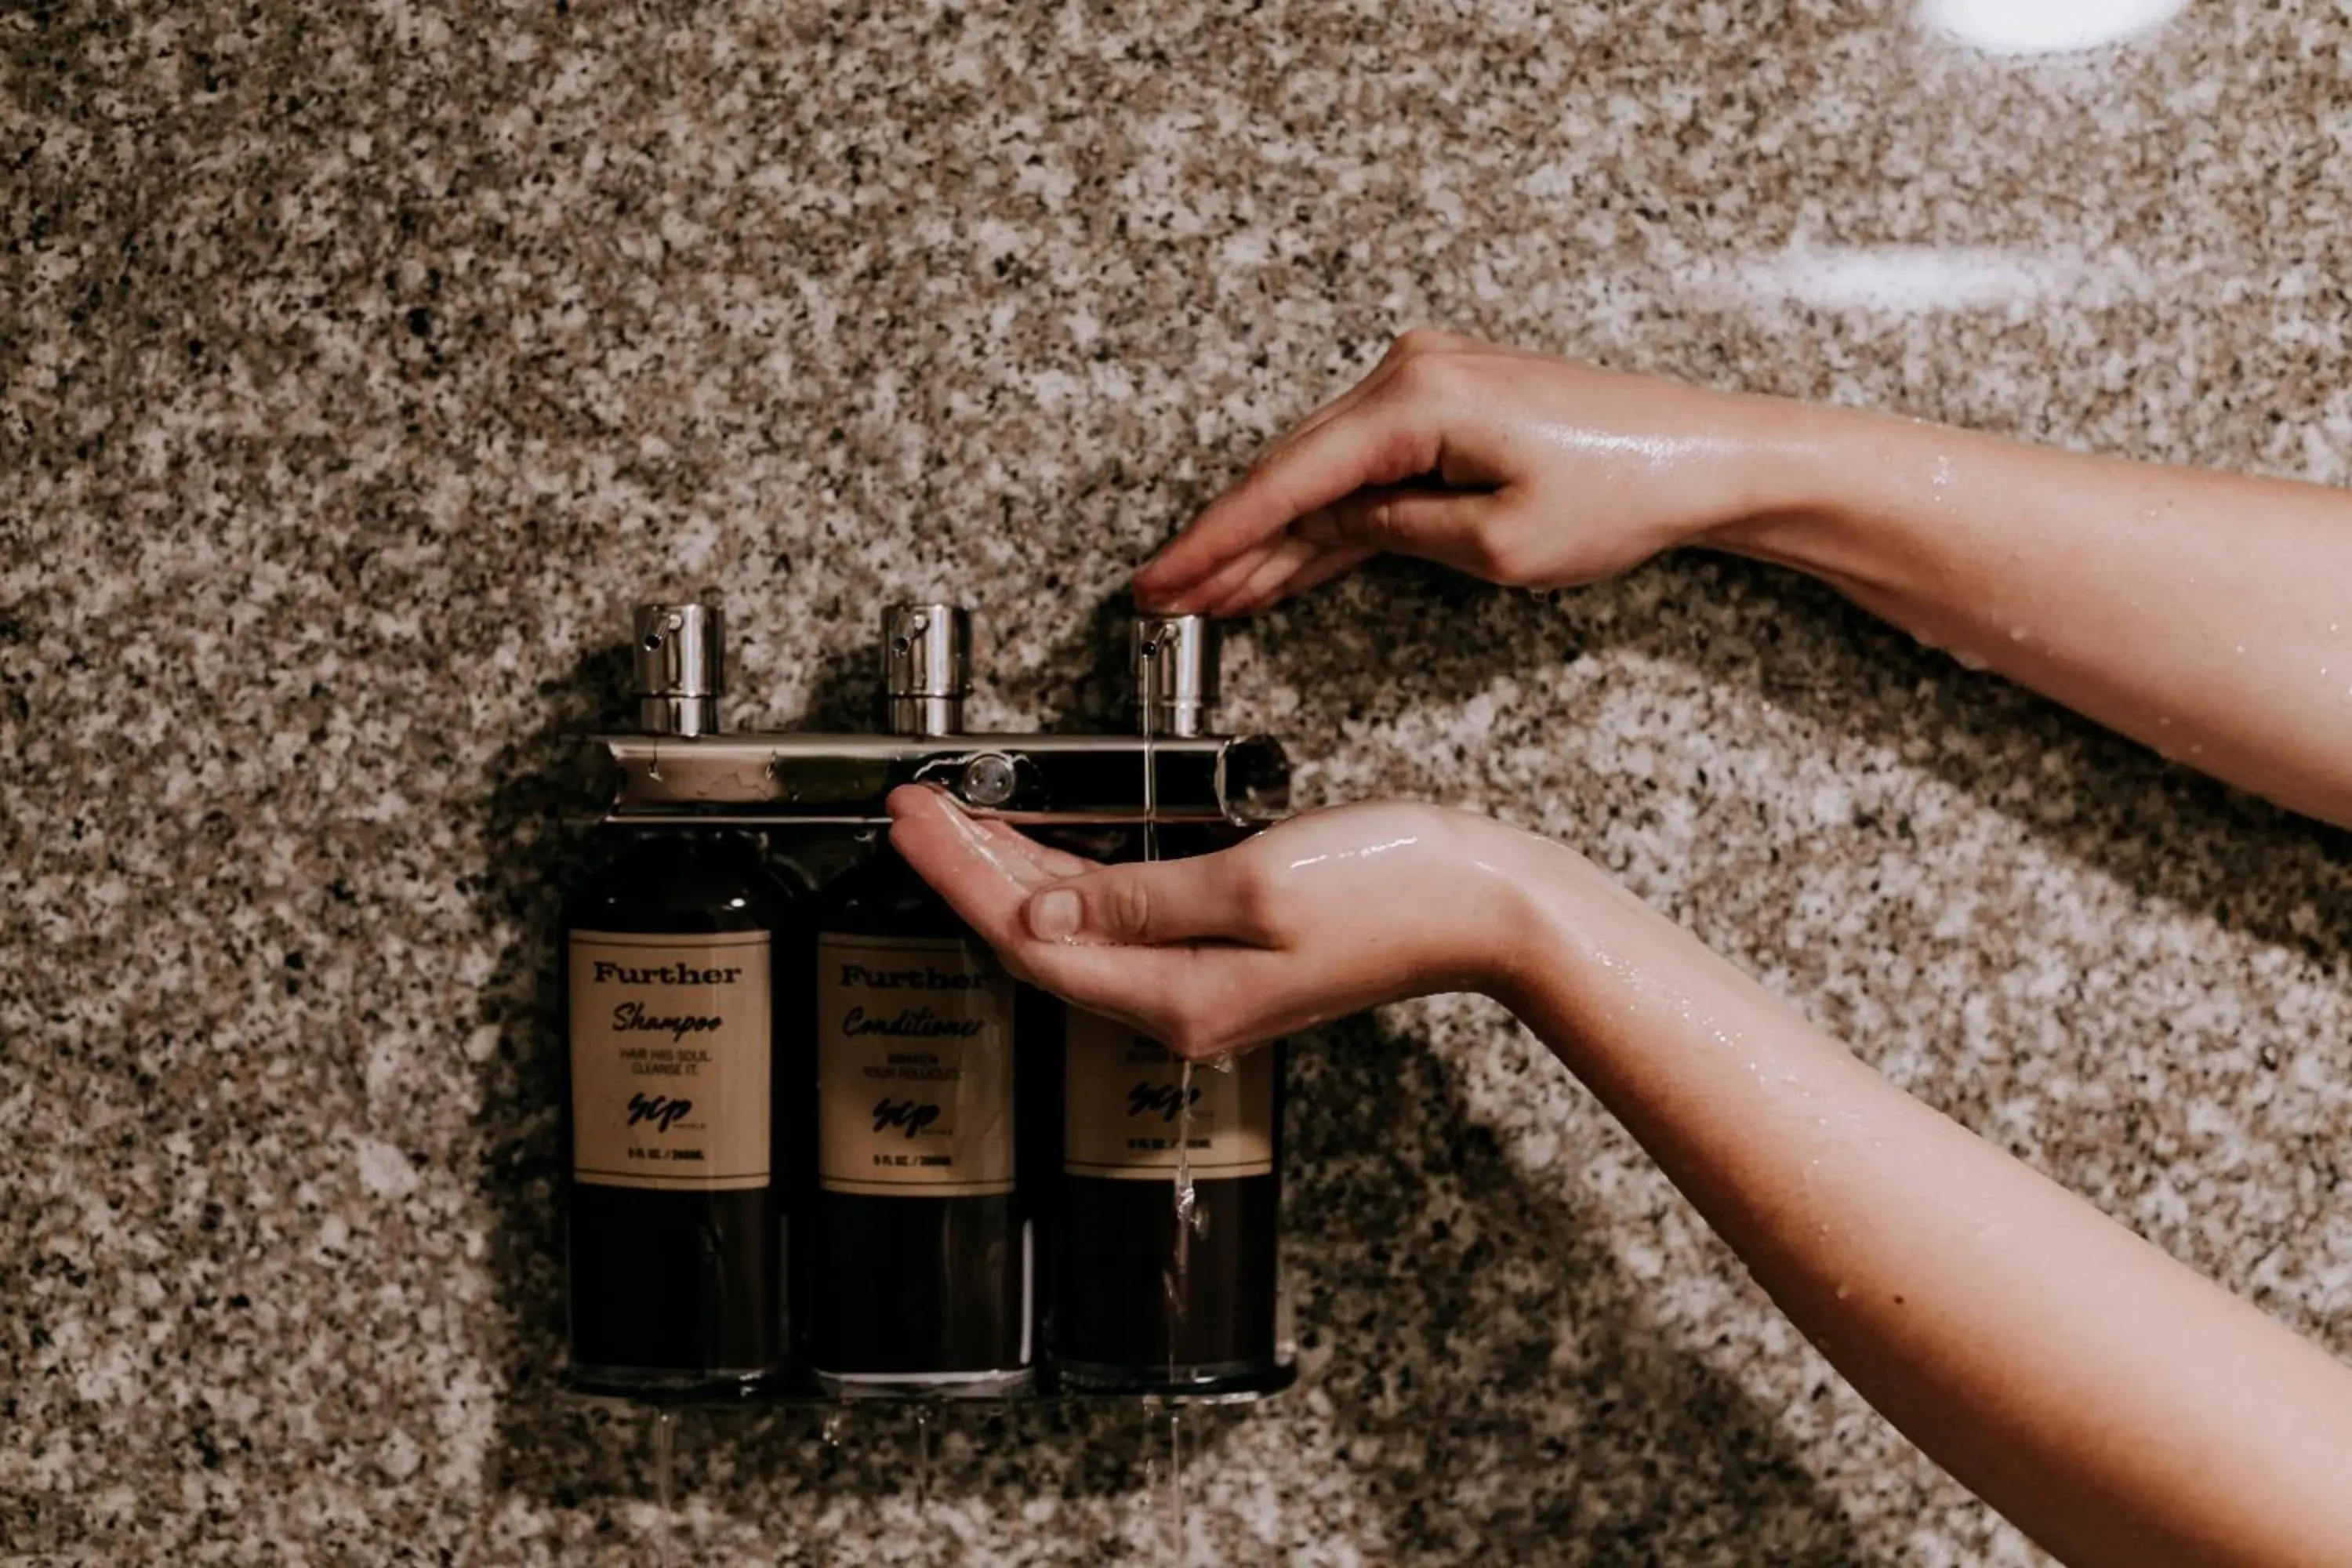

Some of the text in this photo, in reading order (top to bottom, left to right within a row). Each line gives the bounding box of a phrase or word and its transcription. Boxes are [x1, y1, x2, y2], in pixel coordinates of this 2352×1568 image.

[594, 961, 742, 985] Further
[840, 965, 990, 989] Further
[613, 1002, 722, 1043] Shampoo
[843, 1005, 987, 1037] Conditioner
